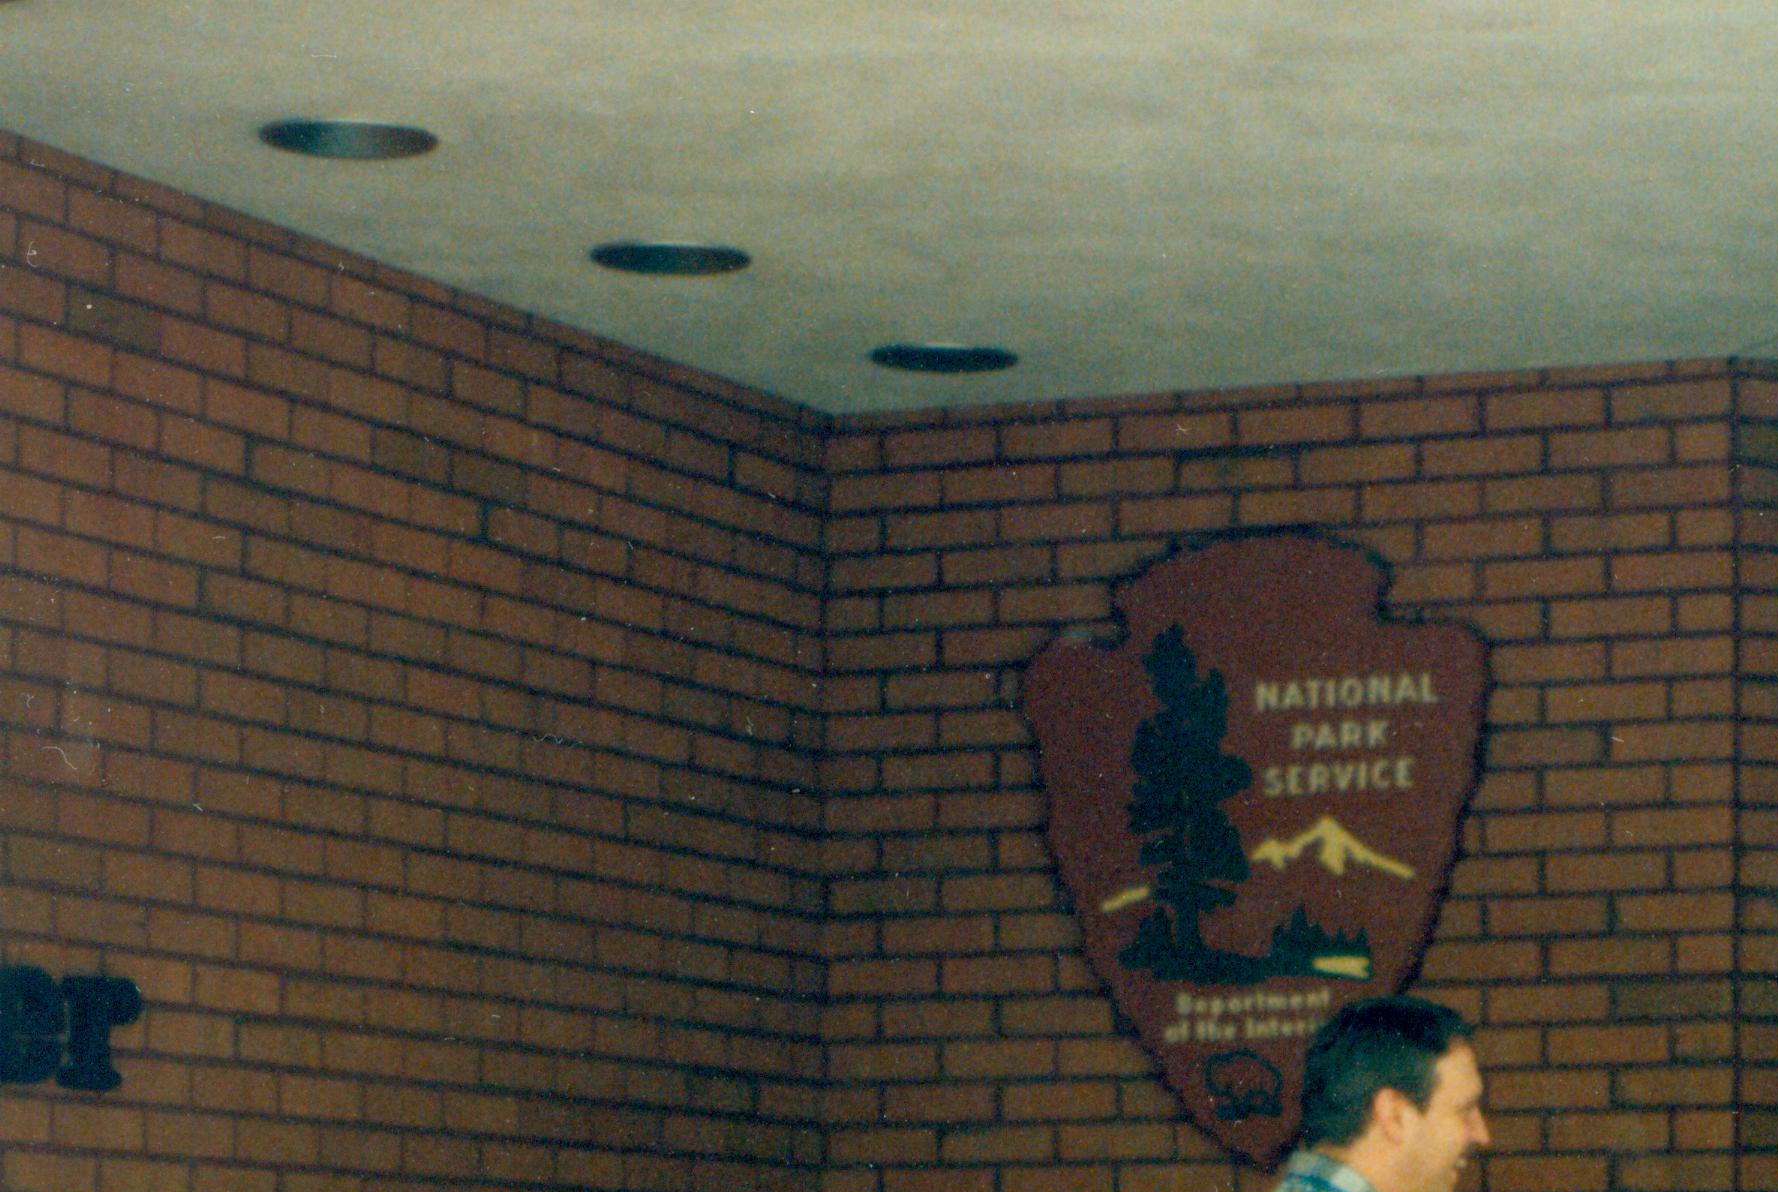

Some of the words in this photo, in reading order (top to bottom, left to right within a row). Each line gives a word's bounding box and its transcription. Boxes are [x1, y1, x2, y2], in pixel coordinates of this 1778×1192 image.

[1255, 672, 1438, 713] NATIONAL
[1290, 719, 1390, 750] PARK
[1263, 756, 1415, 798] SERVICE
[1176, 985, 1332, 1015] Department
[1163, 1018, 1189, 1044] of
[1197, 1018, 1237, 1042] the
[1246, 1013, 1322, 1040] Interi
